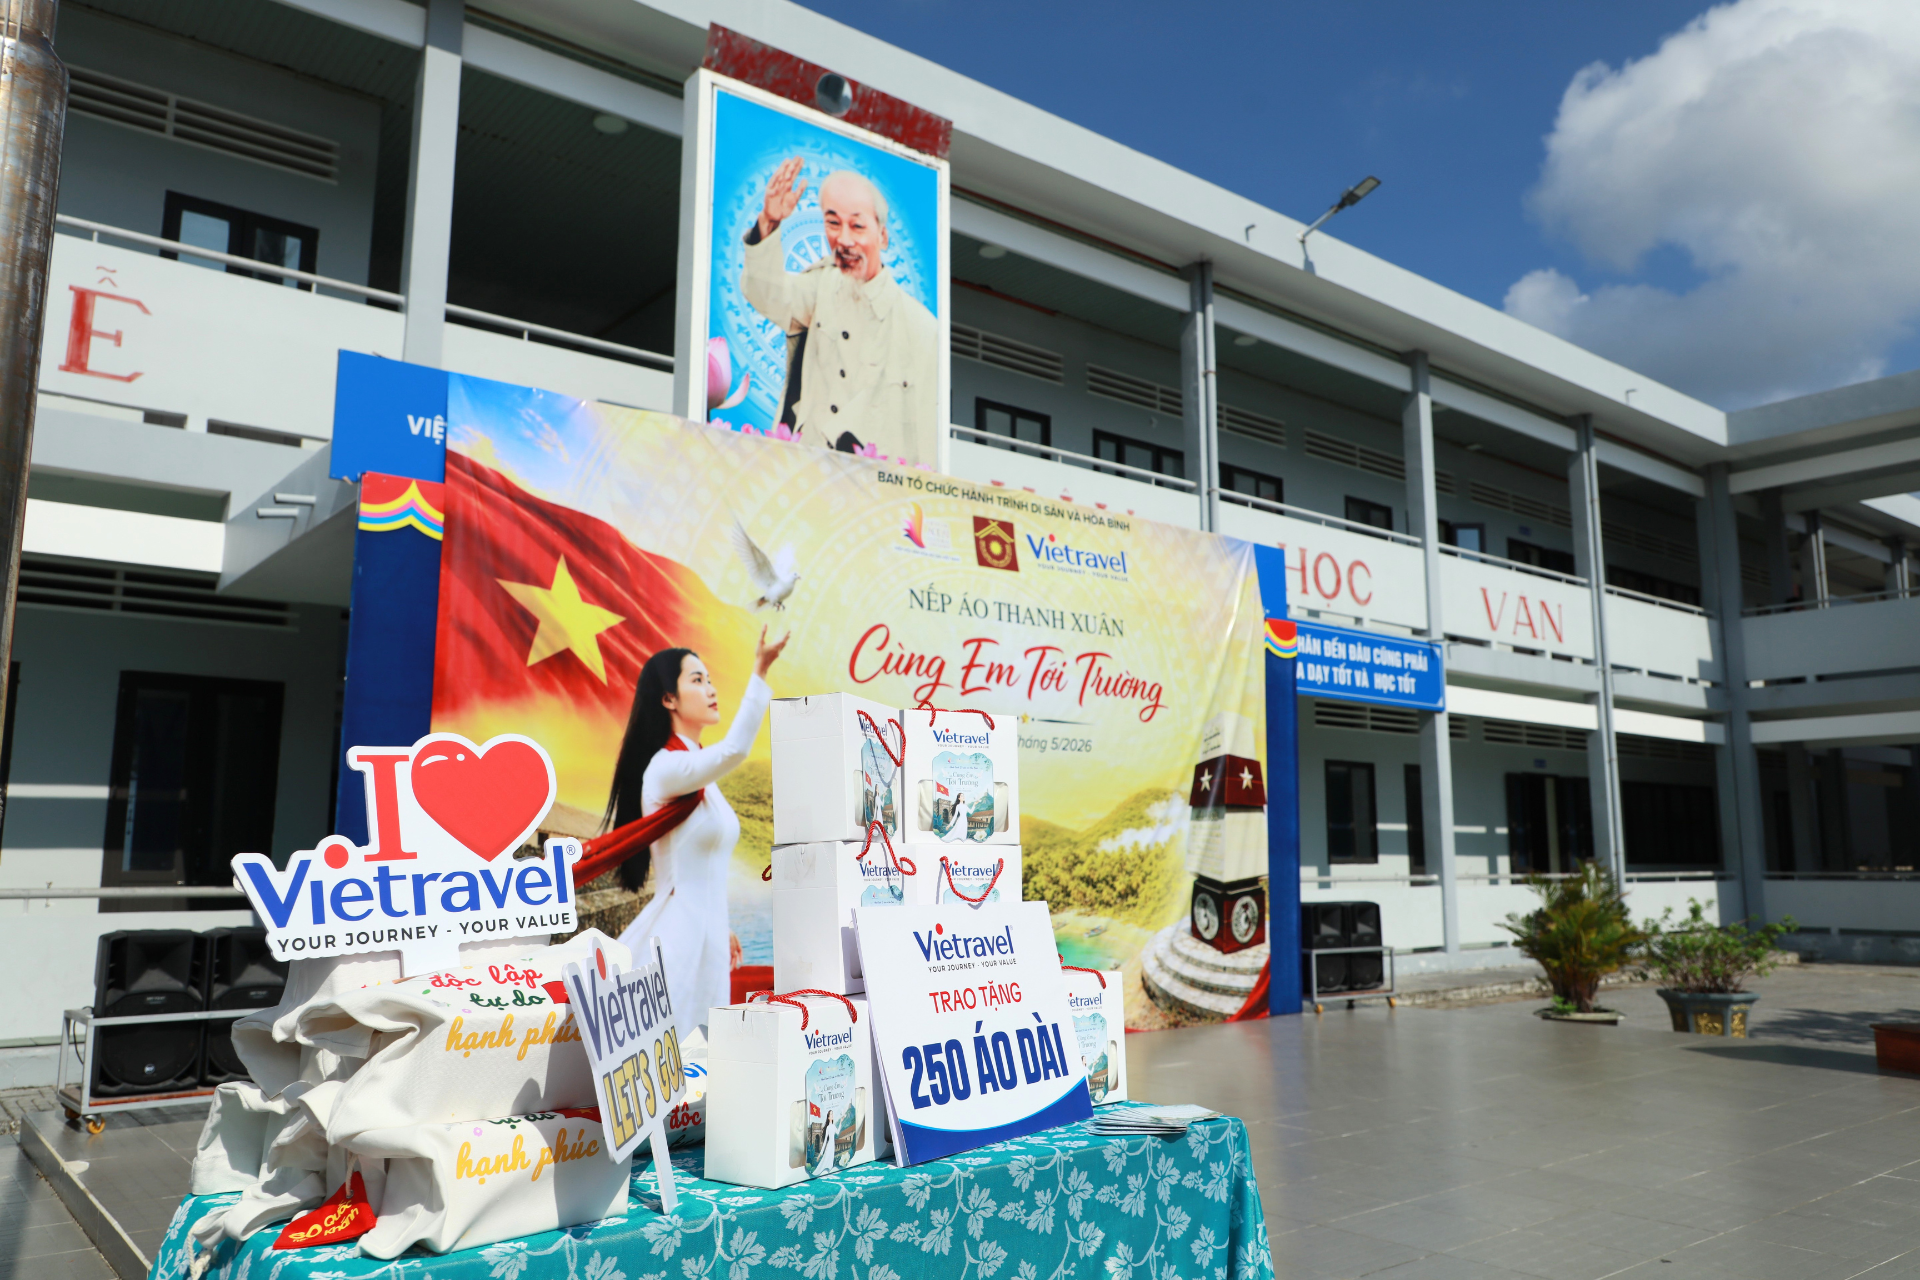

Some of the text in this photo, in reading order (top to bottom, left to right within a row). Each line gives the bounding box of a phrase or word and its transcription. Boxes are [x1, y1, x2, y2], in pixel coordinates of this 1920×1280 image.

[407, 414, 447, 445] VIỆ
[877, 471, 904, 486] BAN
[926, 478, 959, 498] CHỨC
[962, 486, 994, 505] HÀNH
[997, 493, 1029, 511] TRÌNH
[1031, 502, 1042, 514] DI
[1067, 507, 1081, 522] VÀ
[1083, 509, 1106, 527] HÒA
[1108, 515, 1131, 532] BÌNH
[1026, 533, 1128, 574] Vietravel
[908, 582, 1125, 637] NẾP ÁO THANH XUÂN
[1323, 637, 1347, 661] ĐẾN
[1373, 645, 1403, 669] CŨNG
[849, 623, 1170, 723] Cùng Em Tới Trường
[1307, 663, 1331, 685] DẠY
[1332, 662, 1353, 686] TỐT
[1354, 667, 1370, 689] VÀ
[1374, 672, 1396, 694] HỌC
[1397, 671, 1417, 695] TỐT
[933, 728, 990, 745] Vietravel
[1017, 734, 1093, 754] háng 5/2026
[356, 754, 418, 862] I
[277, 936, 337, 953] YOUR
[345, 924, 439, 947] JOURNEY
[459, 918, 509, 934] YOUR
[516, 913, 571, 929] VALUE
[912, 923, 1015, 962] Vietravel
[430, 964, 543, 991] độc lập
[927, 958, 1017, 973] YOUR JOURNEY YOUR VALUE
[469, 989, 546, 1010] tự do
[572, 945, 672, 1061] Vietravel
[929, 980, 1023, 1014] TRAO TẶNG
[445, 1013, 516, 1058] hạnh
[805, 1026, 853, 1050] Vietravel
[902, 1011, 1070, 1109] 250 ÁO DÀI
[602, 1025, 685, 1152] LET'S GO!
[669, 1101, 702, 1132] độc
[456, 1127, 600, 1185] hạnh phúc
